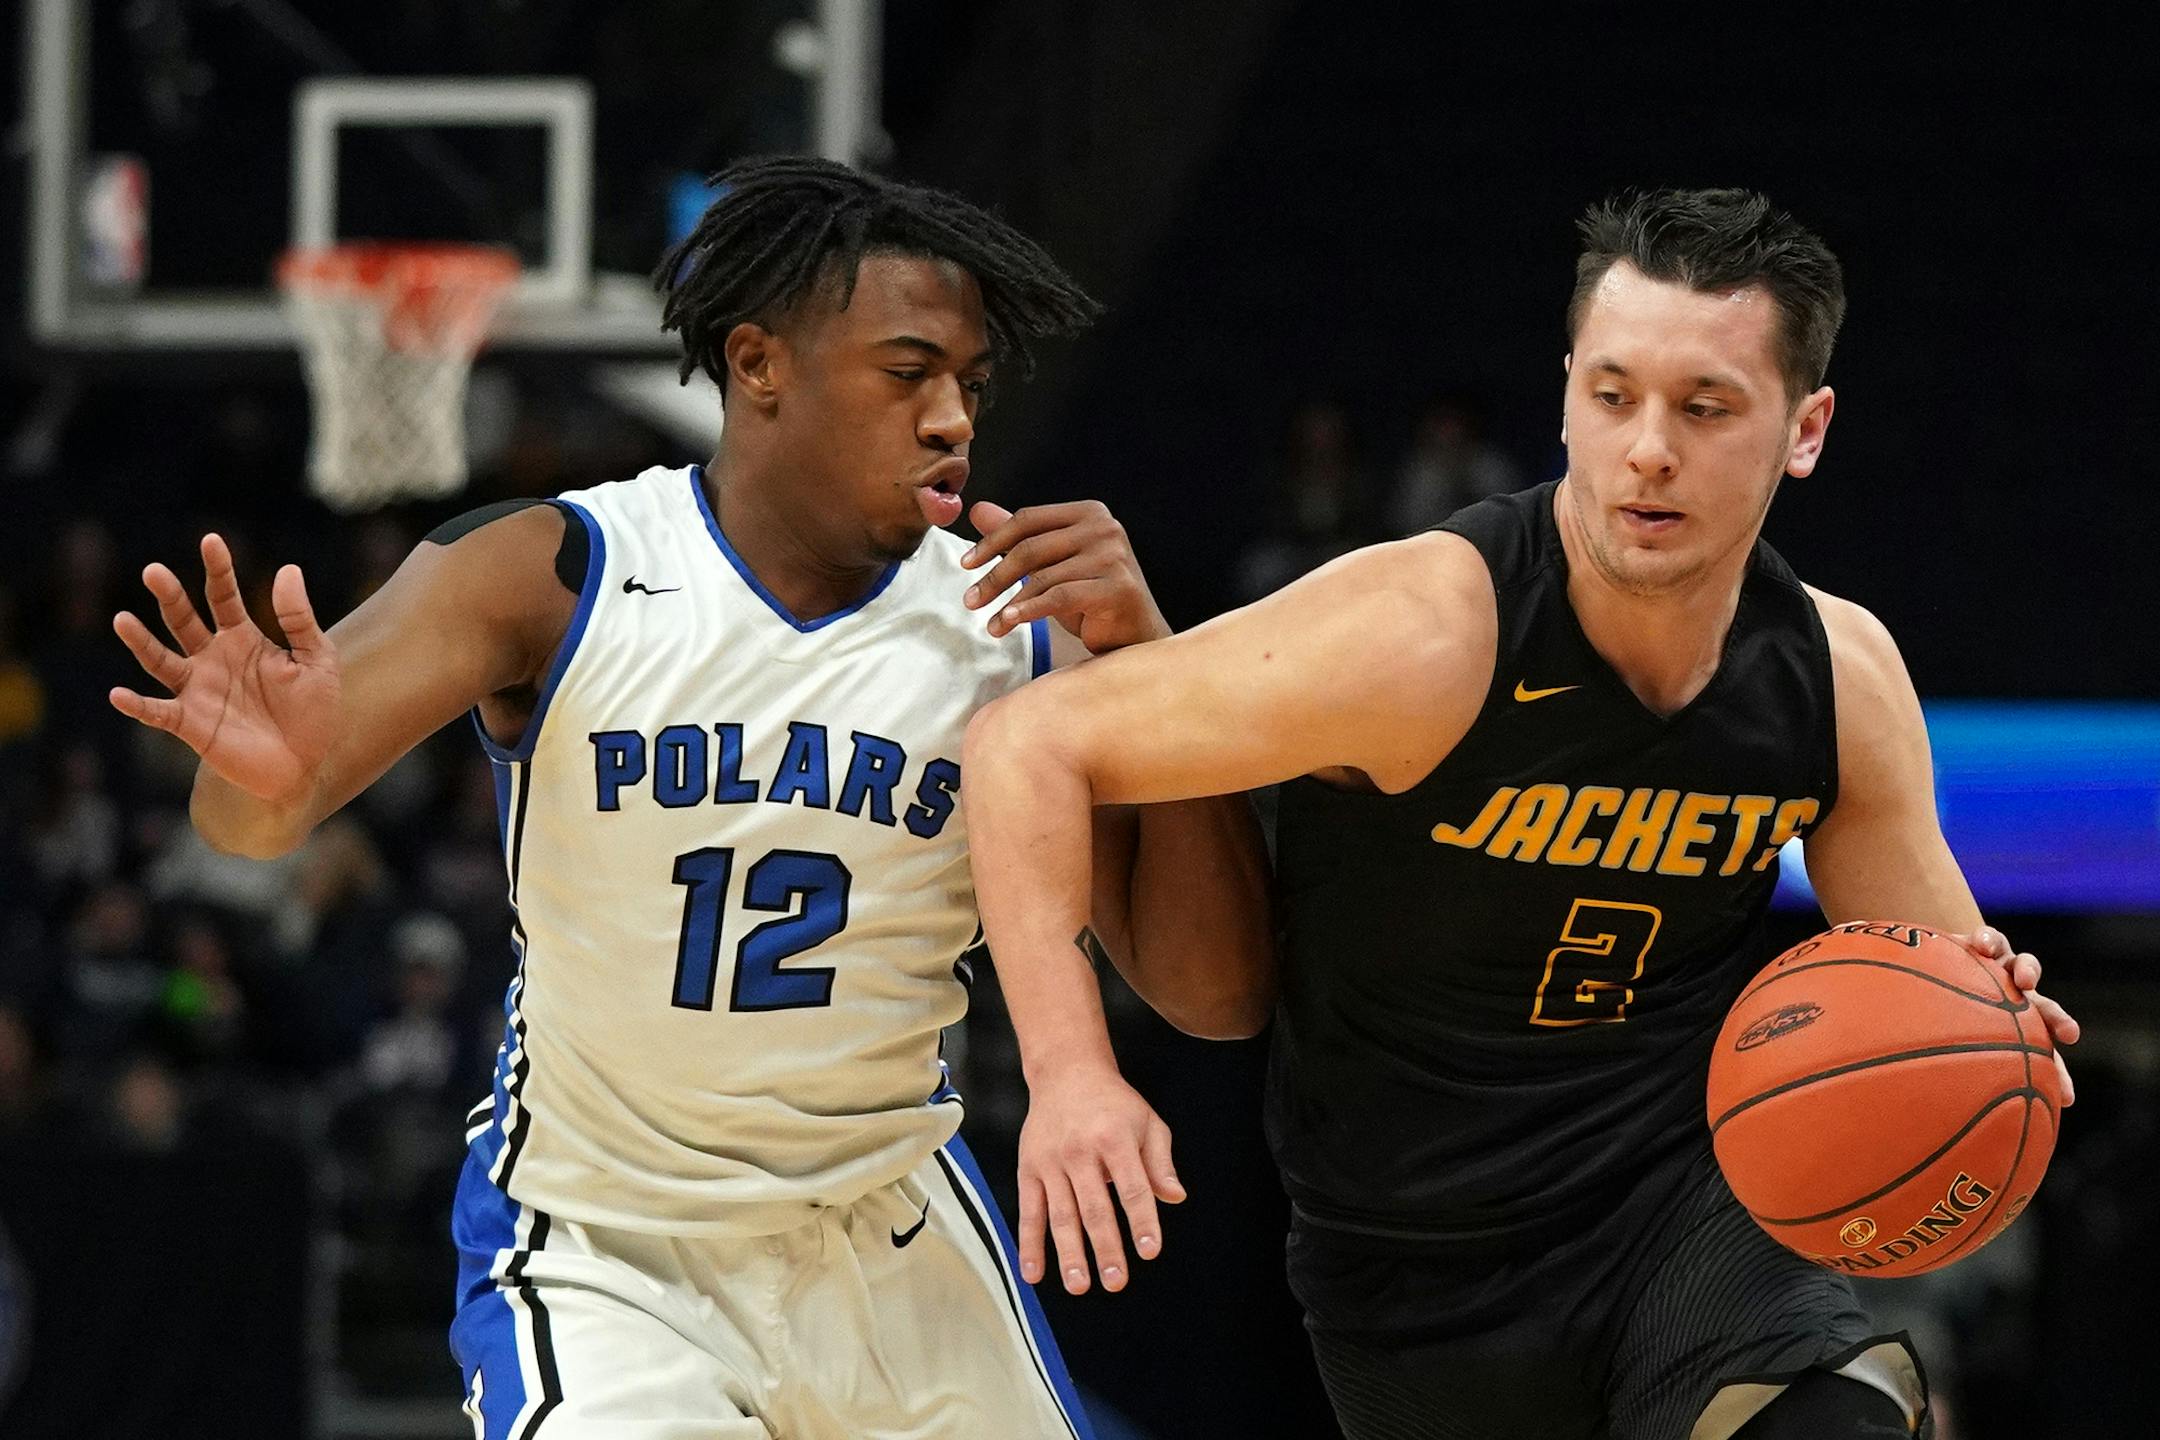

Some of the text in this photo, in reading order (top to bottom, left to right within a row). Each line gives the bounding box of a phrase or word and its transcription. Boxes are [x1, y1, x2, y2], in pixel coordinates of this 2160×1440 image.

[588, 721, 961, 839] POLARS
[1431, 783, 1820, 876] JACKETS
[671, 846, 853, 1013] 12
[1529, 897, 1662, 1028] 2
[1810, 1171, 1995, 1271] PALDING
